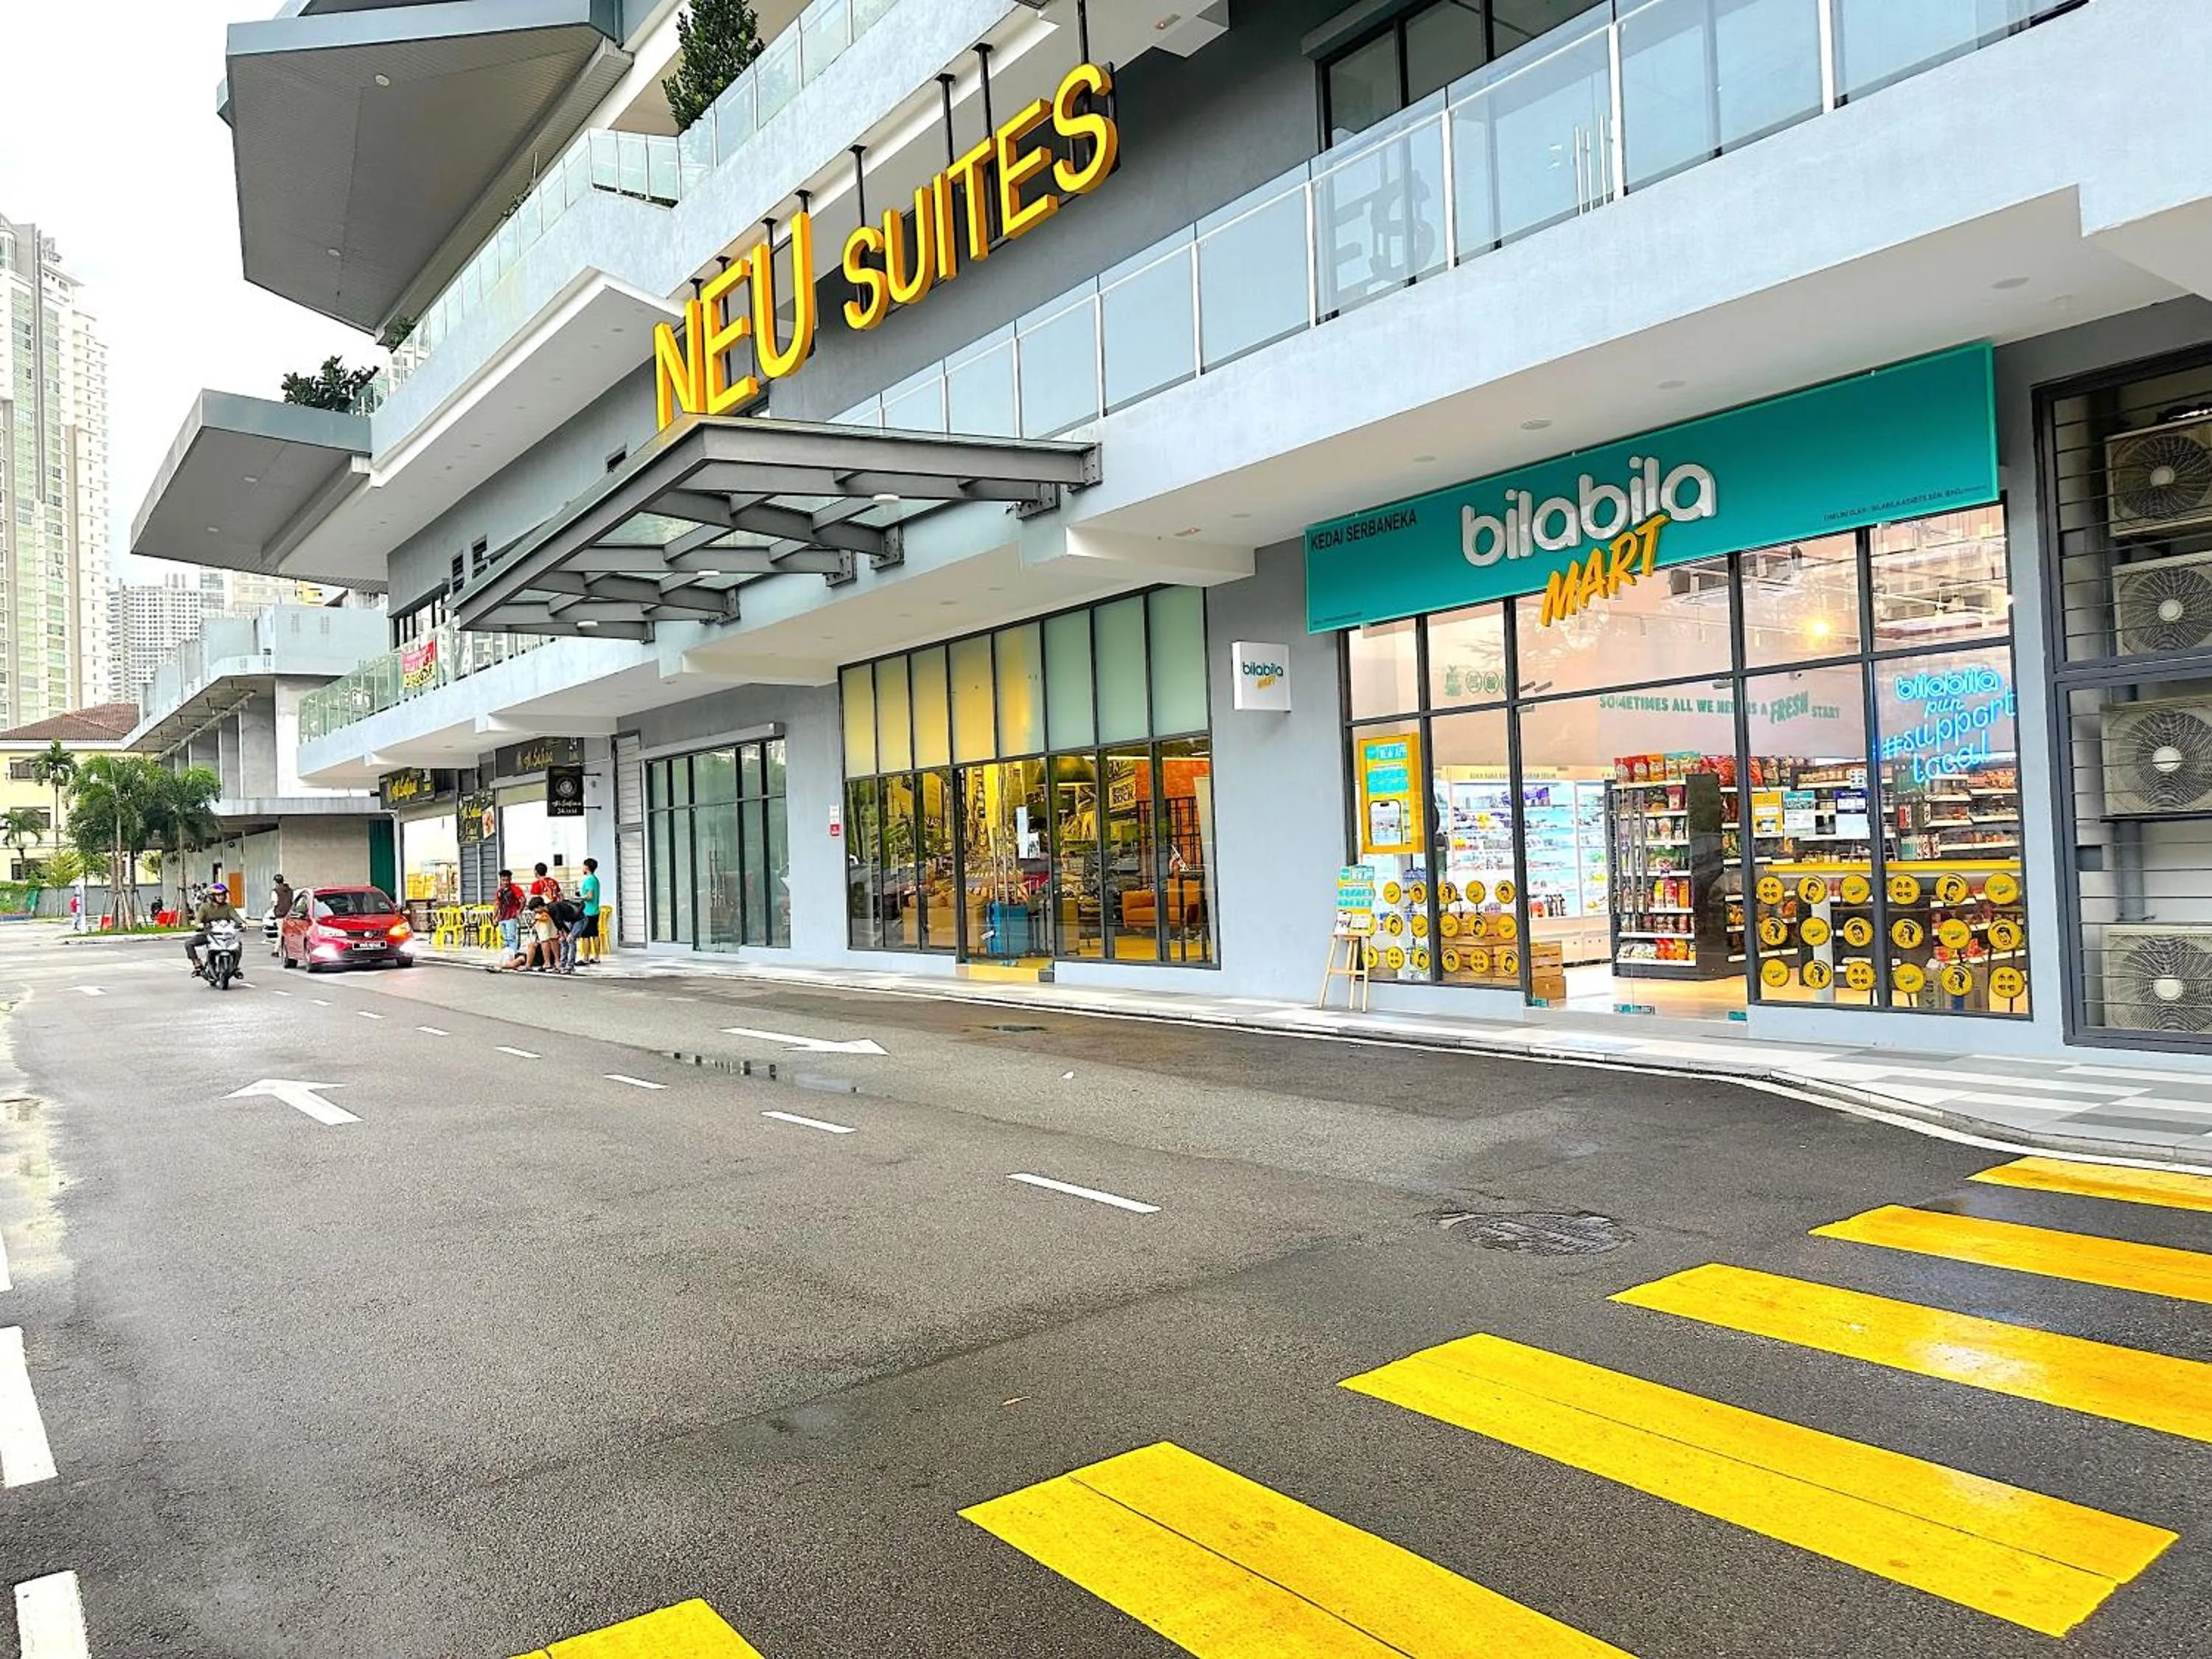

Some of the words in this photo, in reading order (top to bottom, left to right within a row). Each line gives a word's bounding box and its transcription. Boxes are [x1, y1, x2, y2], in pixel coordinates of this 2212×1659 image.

[653, 212, 815, 430] NEU
[843, 63, 1118, 330] SUITES
[1311, 528, 1343, 551] KEDAI
[1346, 508, 1417, 543] SERBANEKA
[1461, 456, 1717, 566] bilabila
[1541, 514, 1671, 627] MART
[1599, 694, 1669, 712] SOMETIMES
[1672, 698, 1694, 712] ALL
[1697, 699, 1713, 713] WE
[1770, 691, 1809, 724] FRESH
[1812, 706, 1840, 719] START
[1895, 667, 2000, 701] bilabila
[1924, 698, 1965, 719] pun
[1882, 684, 2017, 757] #support
[1913, 729, 1992, 784] local
